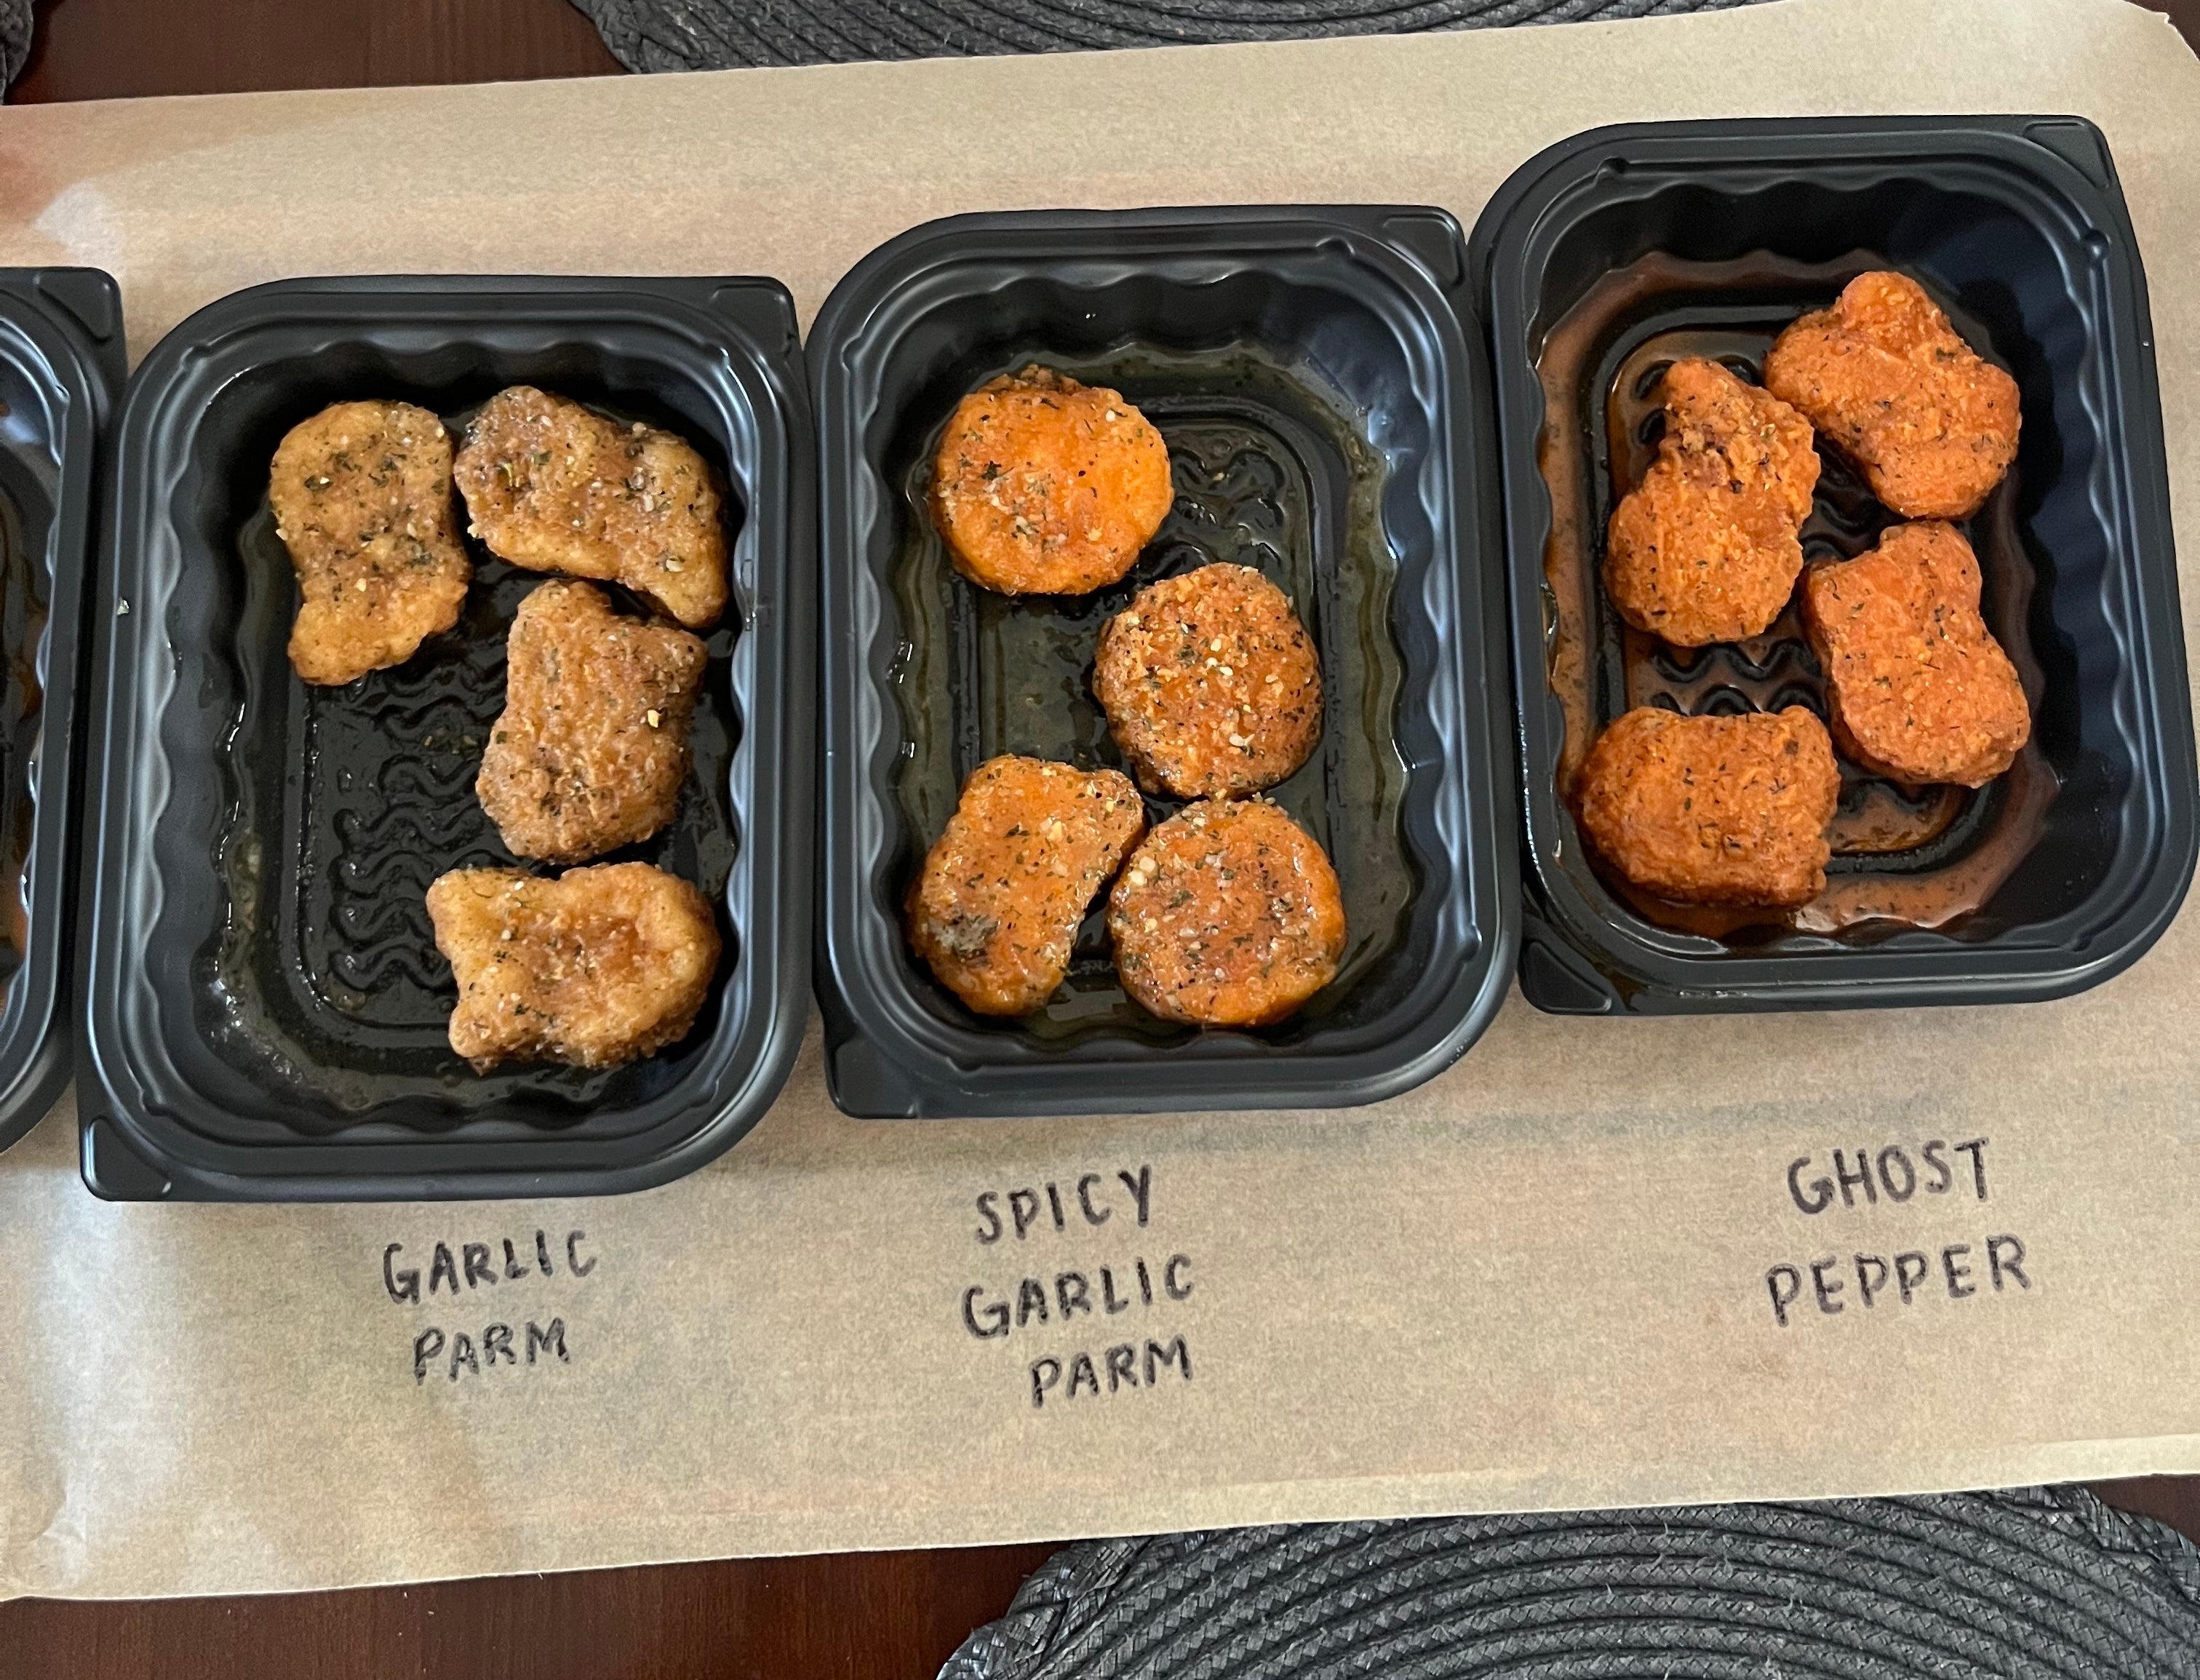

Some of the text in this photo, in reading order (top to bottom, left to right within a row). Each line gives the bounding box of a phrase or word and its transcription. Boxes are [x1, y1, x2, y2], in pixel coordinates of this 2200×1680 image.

[976, 1164, 1152, 1245] SPICY
[1787, 1136, 1990, 1215] GHOST
[382, 1229, 597, 1305] GARLIC
[961, 1253, 1195, 1340] GARLIC
[1765, 1233, 2032, 1328] PEPPER
[413, 1317, 571, 1386] PARM
[1029, 1333, 1194, 1409] PARM
